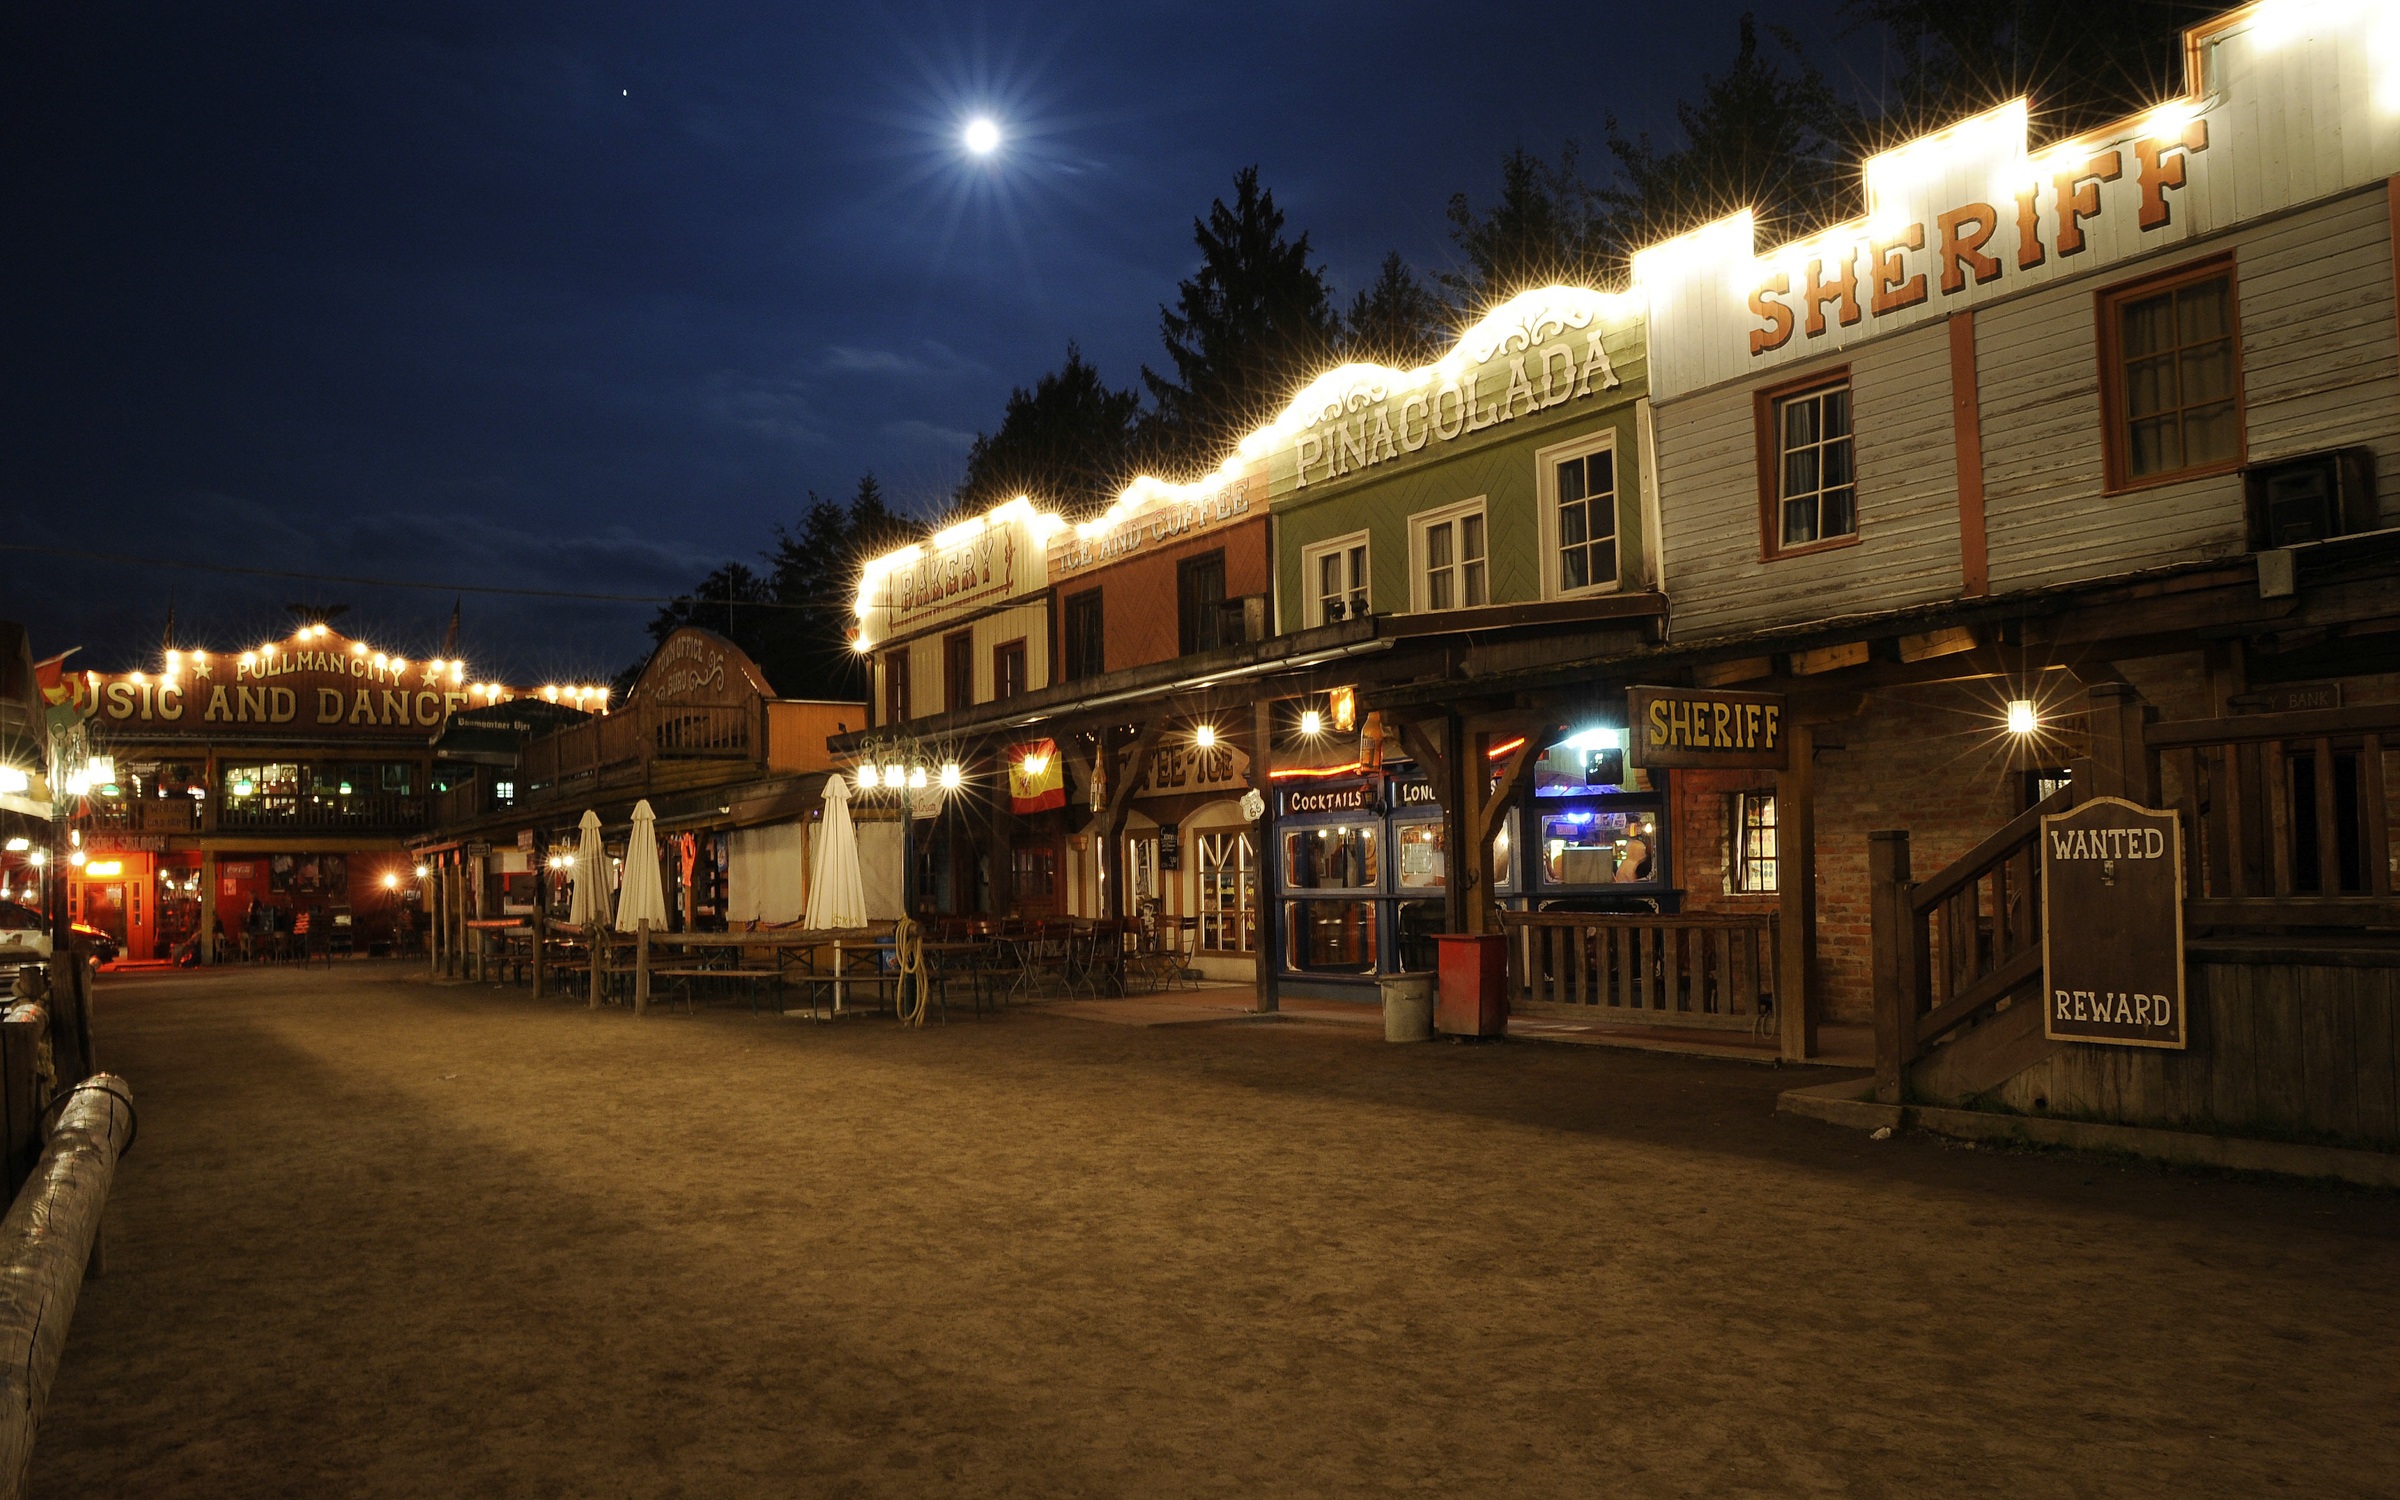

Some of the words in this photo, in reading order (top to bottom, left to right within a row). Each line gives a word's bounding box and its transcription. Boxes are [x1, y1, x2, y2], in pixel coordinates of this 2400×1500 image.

[1748, 118, 2208, 356] SHERIFF
[1295, 329, 1621, 490] PINACOLADA
[1059, 536, 1094, 574] ICE
[1097, 519, 1143, 561] AND
[1149, 481, 1250, 542] COFFEE
[900, 536, 995, 614] BAKERY
[236, 651, 345, 682] PULLMAN
[350, 657, 405, 687] CITY
[657, 641, 676, 678] TOWN
[676, 636, 703, 663] OFFICE
[84, 681, 183, 721] USIC
[204, 685, 297, 723] AND
[316, 688, 469, 727] DANCE
[2288, 691, 2329, 709] BANK
[1649, 699, 1779, 749] SHERIFF
[1290, 791, 1362, 811] COCKTAILS
[2050, 828, 2165, 860] WANTED
[2055, 990, 2171, 1027] REWARD
